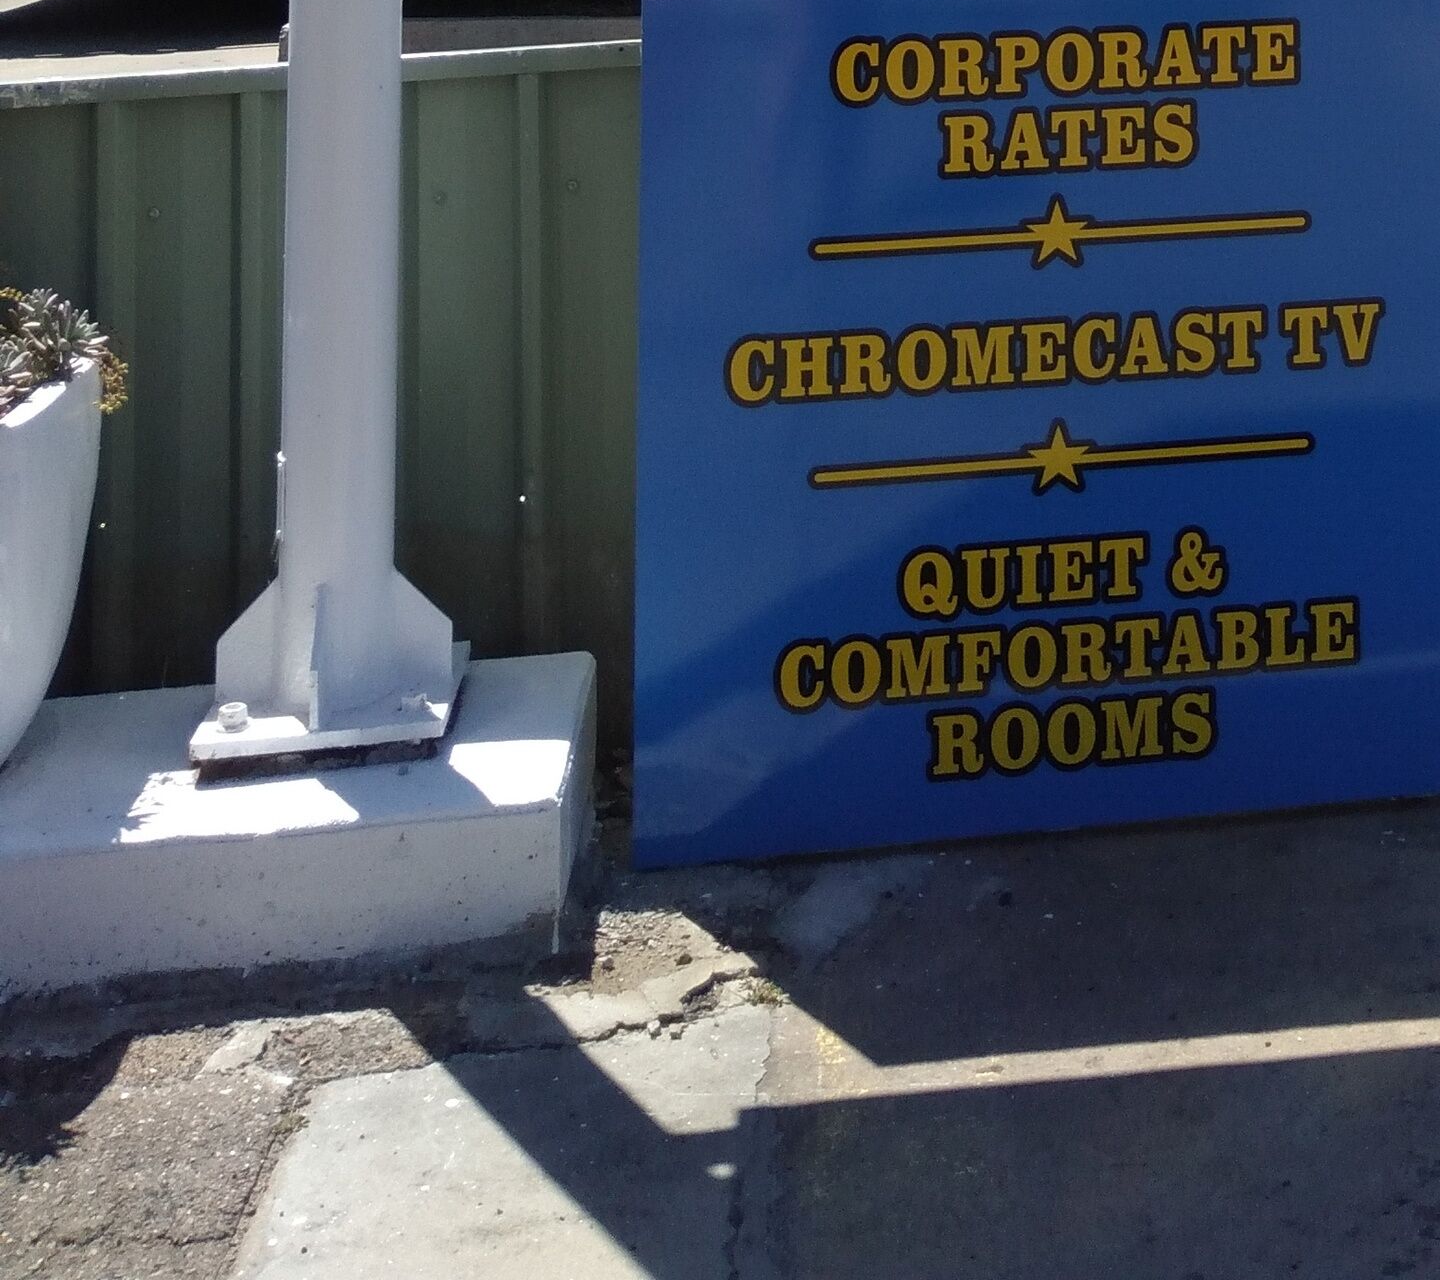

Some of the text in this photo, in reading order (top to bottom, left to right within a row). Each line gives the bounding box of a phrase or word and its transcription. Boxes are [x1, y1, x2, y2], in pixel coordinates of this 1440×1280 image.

[832, 21, 1298, 104] CORPORATE
[939, 99, 1198, 176] RATES
[726, 301, 1383, 405] CHROMECAST TV
[900, 529, 1226, 618] QUIET &
[777, 598, 1358, 710] COMFORTABLE
[927, 689, 1216, 779] ROOMS
